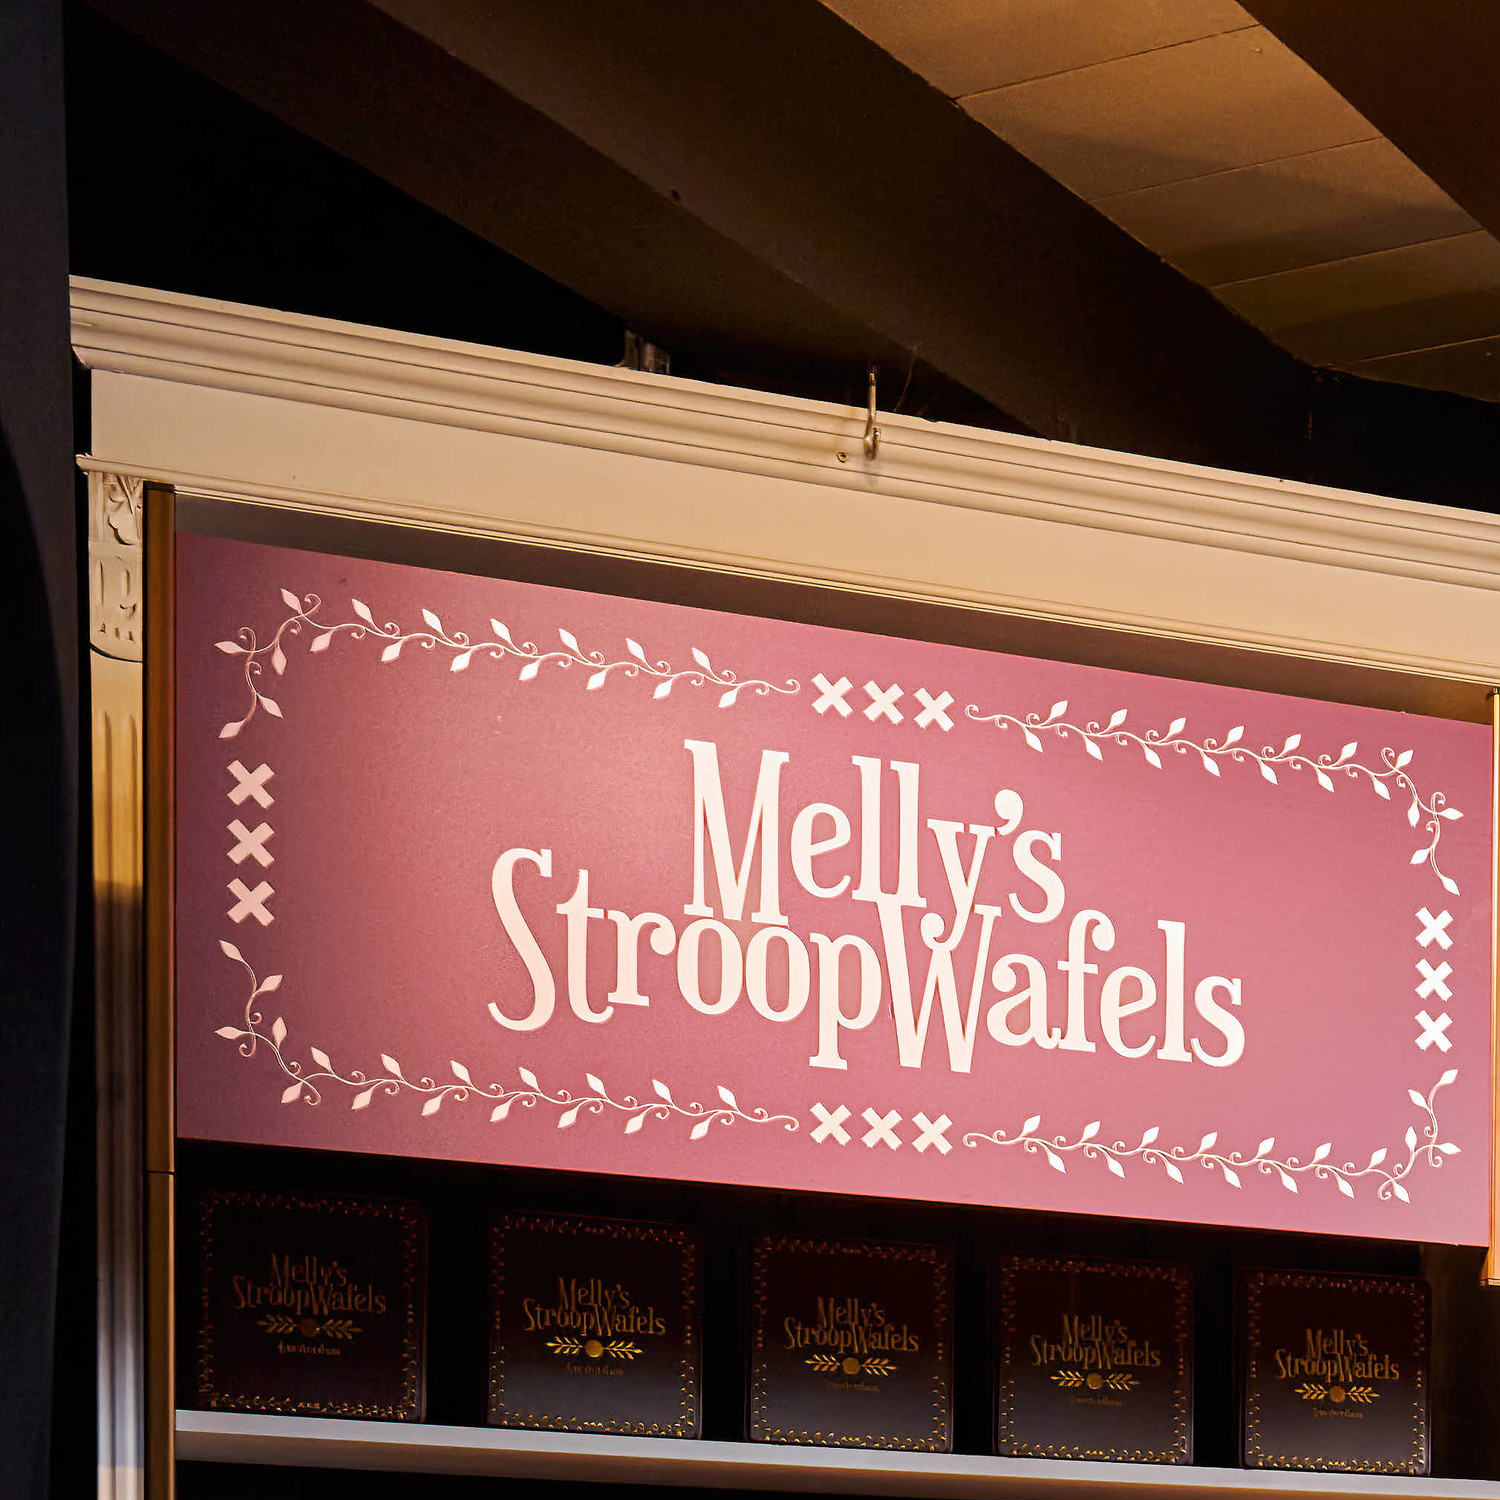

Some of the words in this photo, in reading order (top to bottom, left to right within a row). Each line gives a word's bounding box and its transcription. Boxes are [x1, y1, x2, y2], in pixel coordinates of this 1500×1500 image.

[683, 738, 1065, 946] Melly's
[487, 848, 1246, 1074] StroopWafels
[271, 1251, 348, 1290] Melly's
[232, 1272, 387, 1316] StroopWafels
[558, 1276, 630, 1311] Melly's
[817, 1296, 886, 1329] Melly's
[523, 1297, 666, 1337] StroopWafels
[784, 1315, 920, 1354] StroopWafels
[1062, 1314, 1128, 1347] Melly's
[1030, 1332, 1161, 1369] StroopWafels
[1306, 1328, 1369, 1359] Melly's
[1273, 1347, 1400, 1383] StroopWafels
